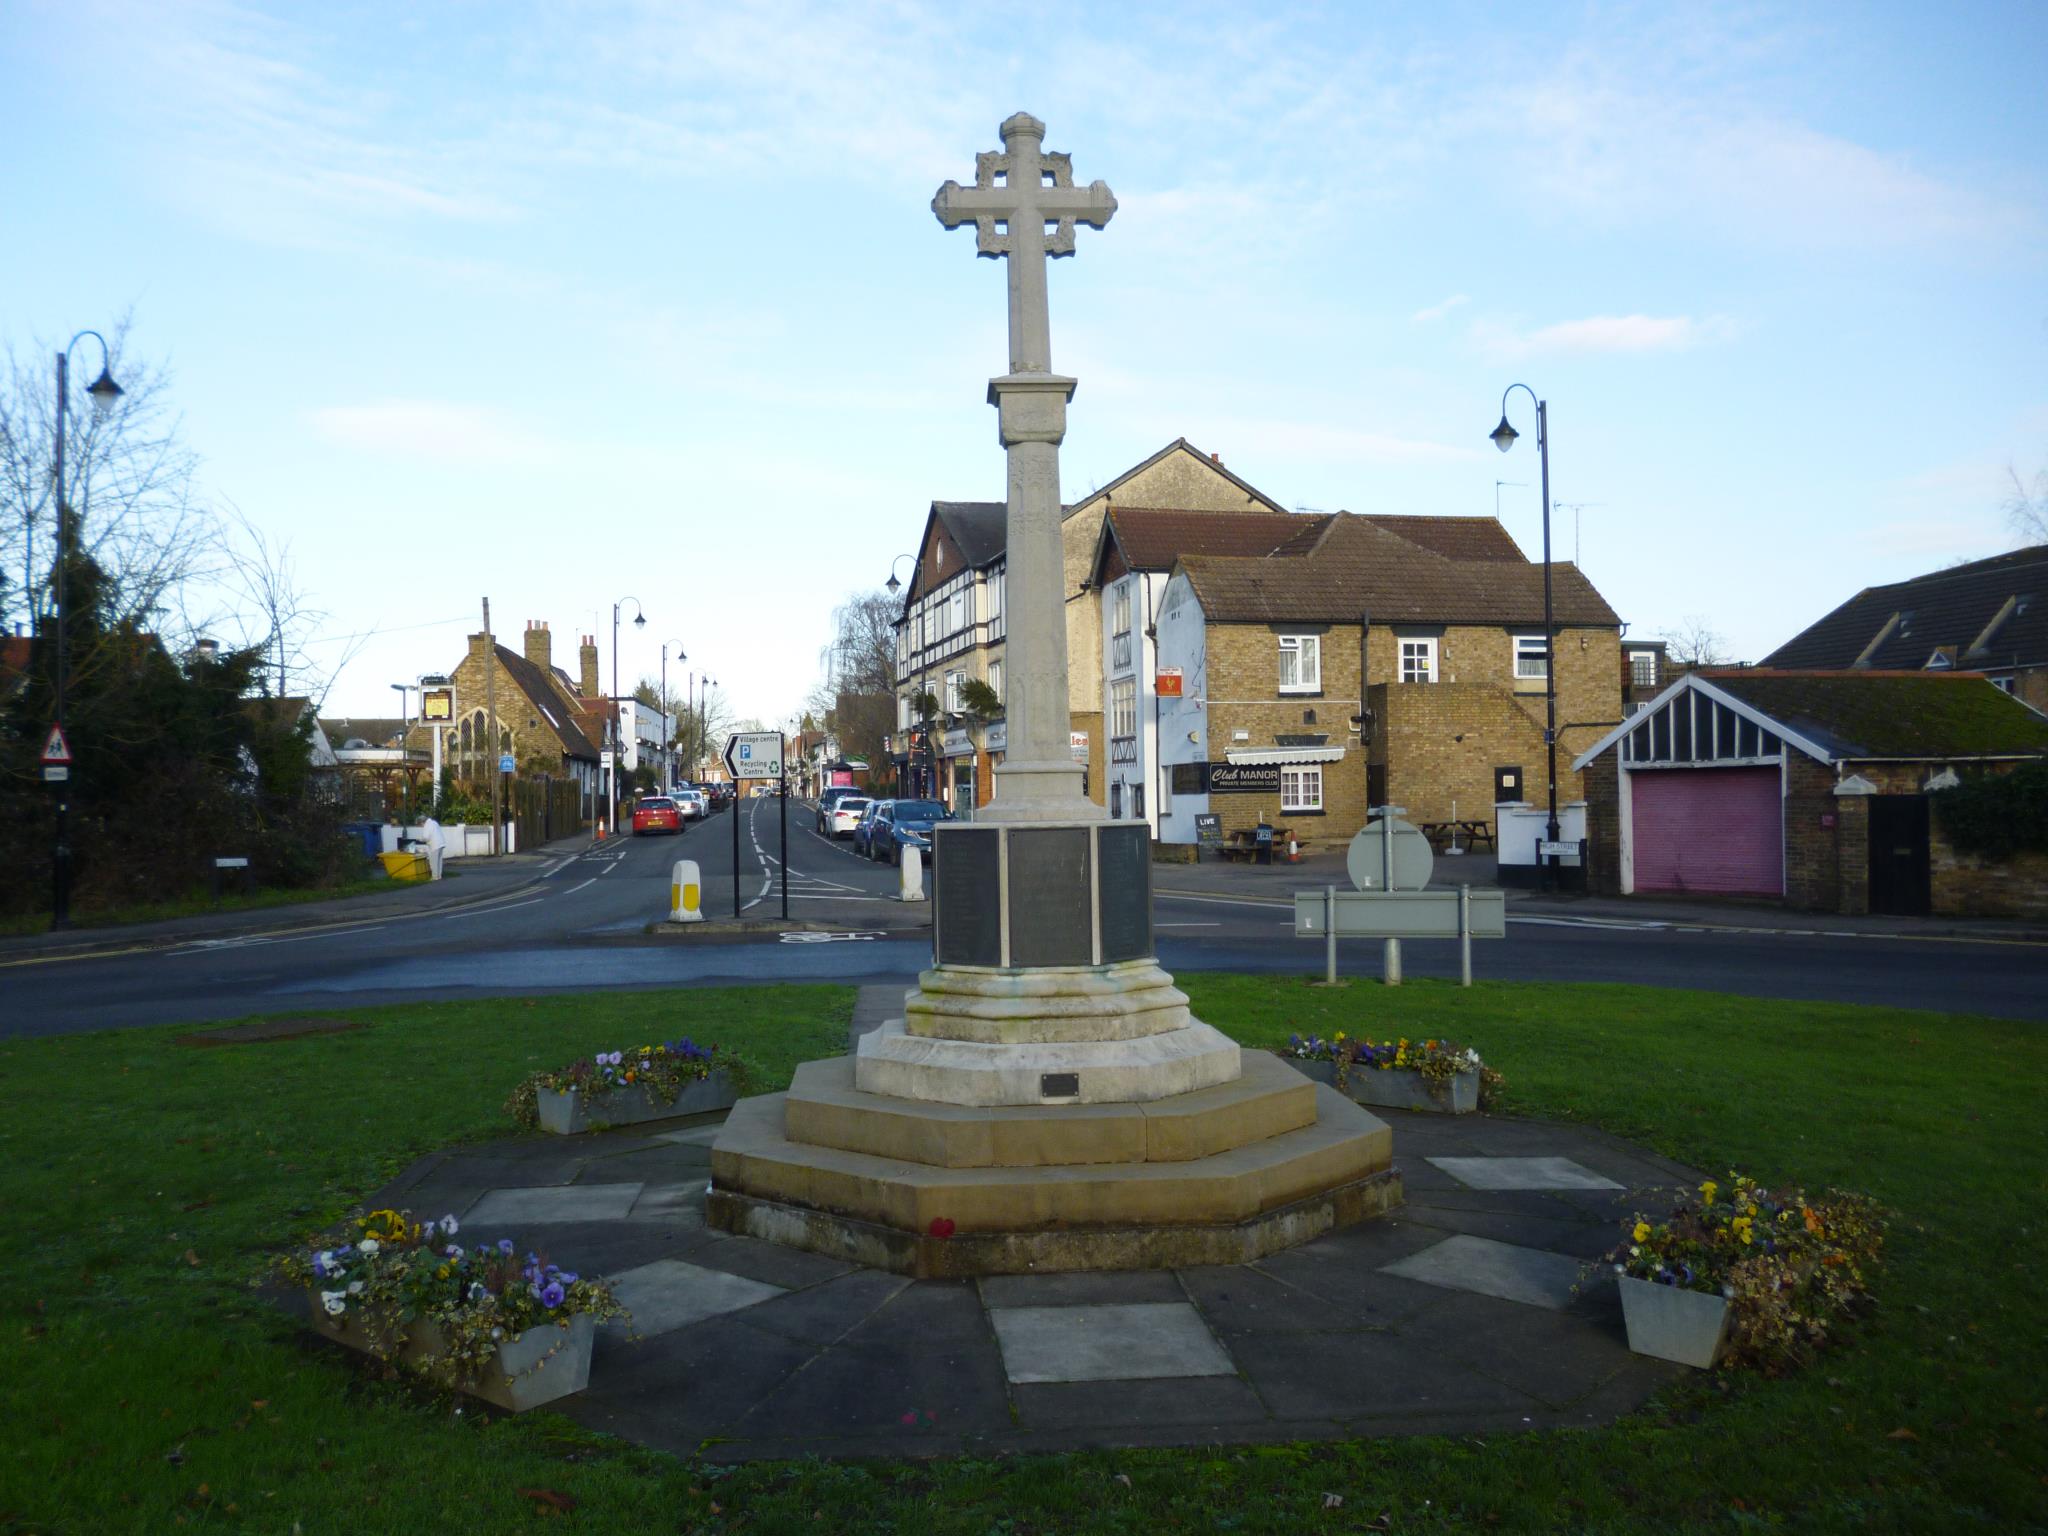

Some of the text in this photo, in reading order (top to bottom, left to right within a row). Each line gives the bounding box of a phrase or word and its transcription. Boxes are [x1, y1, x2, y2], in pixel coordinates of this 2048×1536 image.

[740, 736, 759, 744] Village
[742, 746, 750, 759] P
[740, 761, 768, 769] Recycling
[1212, 769, 1278, 782] Club MANOR
[1200, 818, 1215, 826] LIVE
[1557, 842, 1579, 850] STREET
